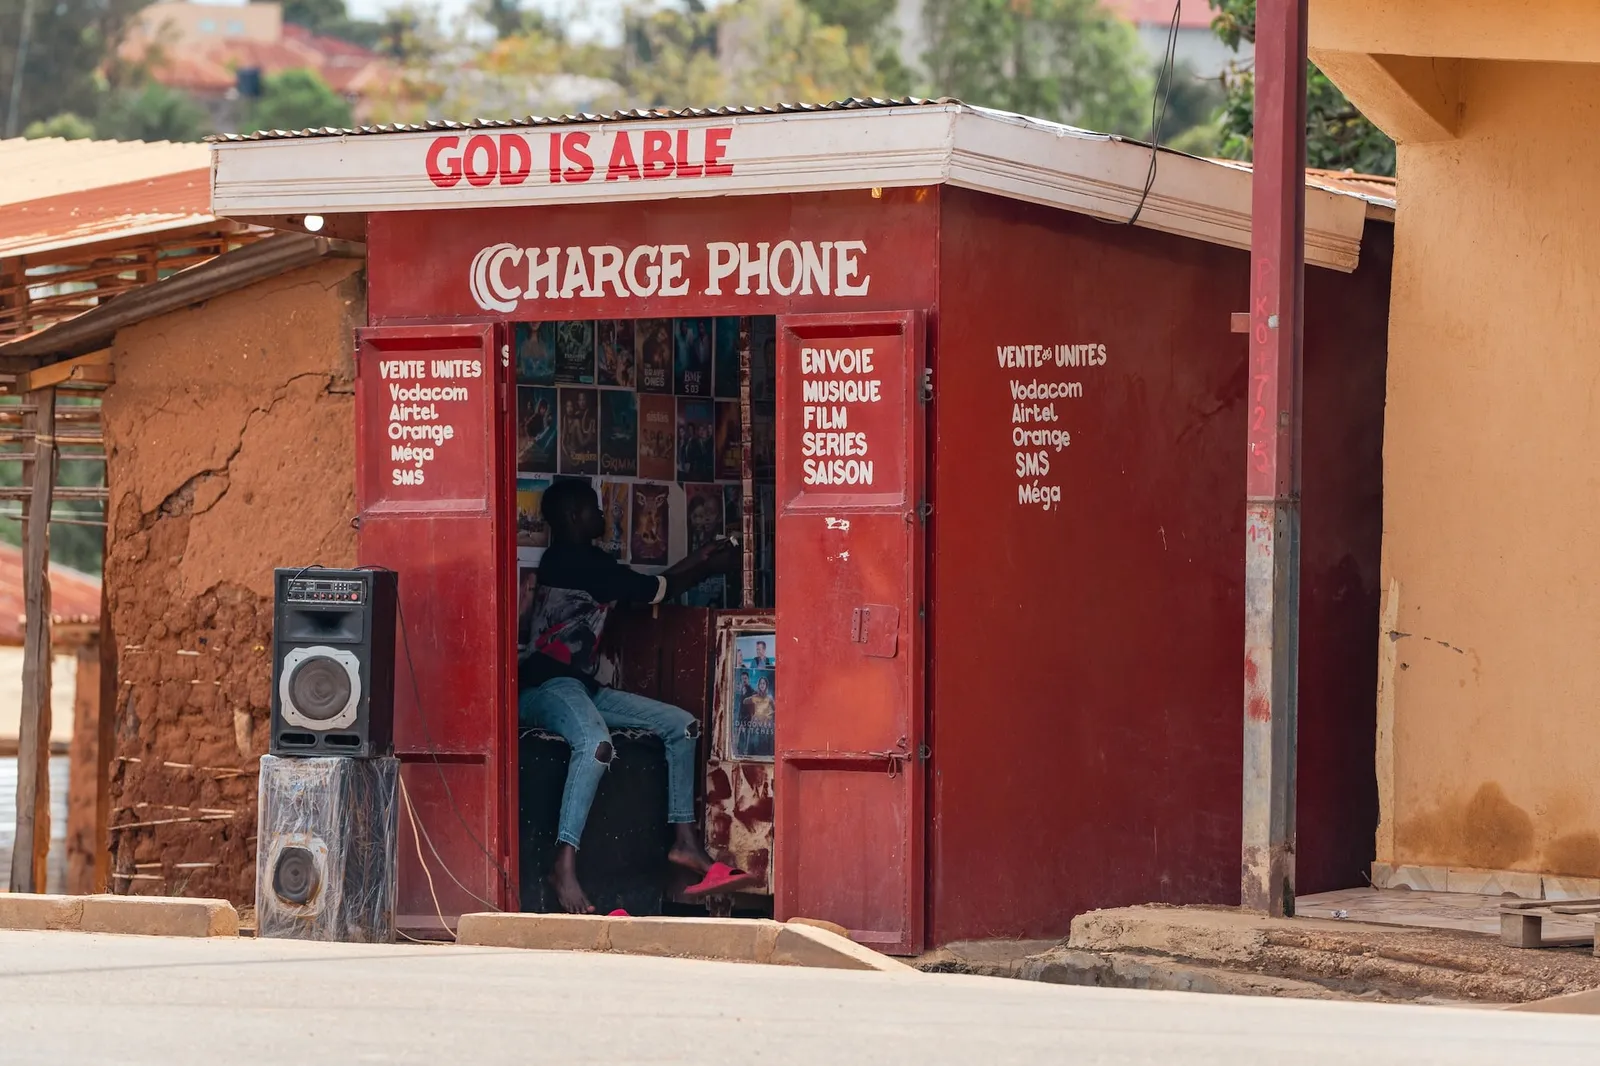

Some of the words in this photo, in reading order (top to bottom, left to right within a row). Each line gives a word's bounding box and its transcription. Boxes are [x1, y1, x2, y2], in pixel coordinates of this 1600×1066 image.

[426, 134, 531, 188] GOD
[549, 132, 594, 184] IS
[606, 128, 733, 182] ABLE
[470, 243, 690, 312] CHARGE
[705, 240, 870, 298] PHONE
[801, 348, 874, 375] ENVOIE
[996, 345, 1042, 369] VENTE
[1055, 344, 1107, 368] UNITES
[379, 360, 425, 379] VENTE
[431, 360, 482, 378] UNITES
[389, 382, 468, 401] Vodacom
[803, 380, 881, 403] MUSIQUE
[1010, 379, 1082, 401] Vodacom
[389, 403, 439, 421] Airtel
[804, 406, 847, 430] FILM
[1012, 402, 1058, 423] Airtel
[388, 422, 454, 446] Orange
[802, 432, 867, 456] SERIES
[1013, 427, 1071, 452] Orange
[391, 443, 434, 468] Méga
[1015, 450, 1050, 478] SMS
[392, 469, 425, 486] SMS
[803, 459, 874, 486] SAISON
[1018, 480, 1061, 511] Méga
